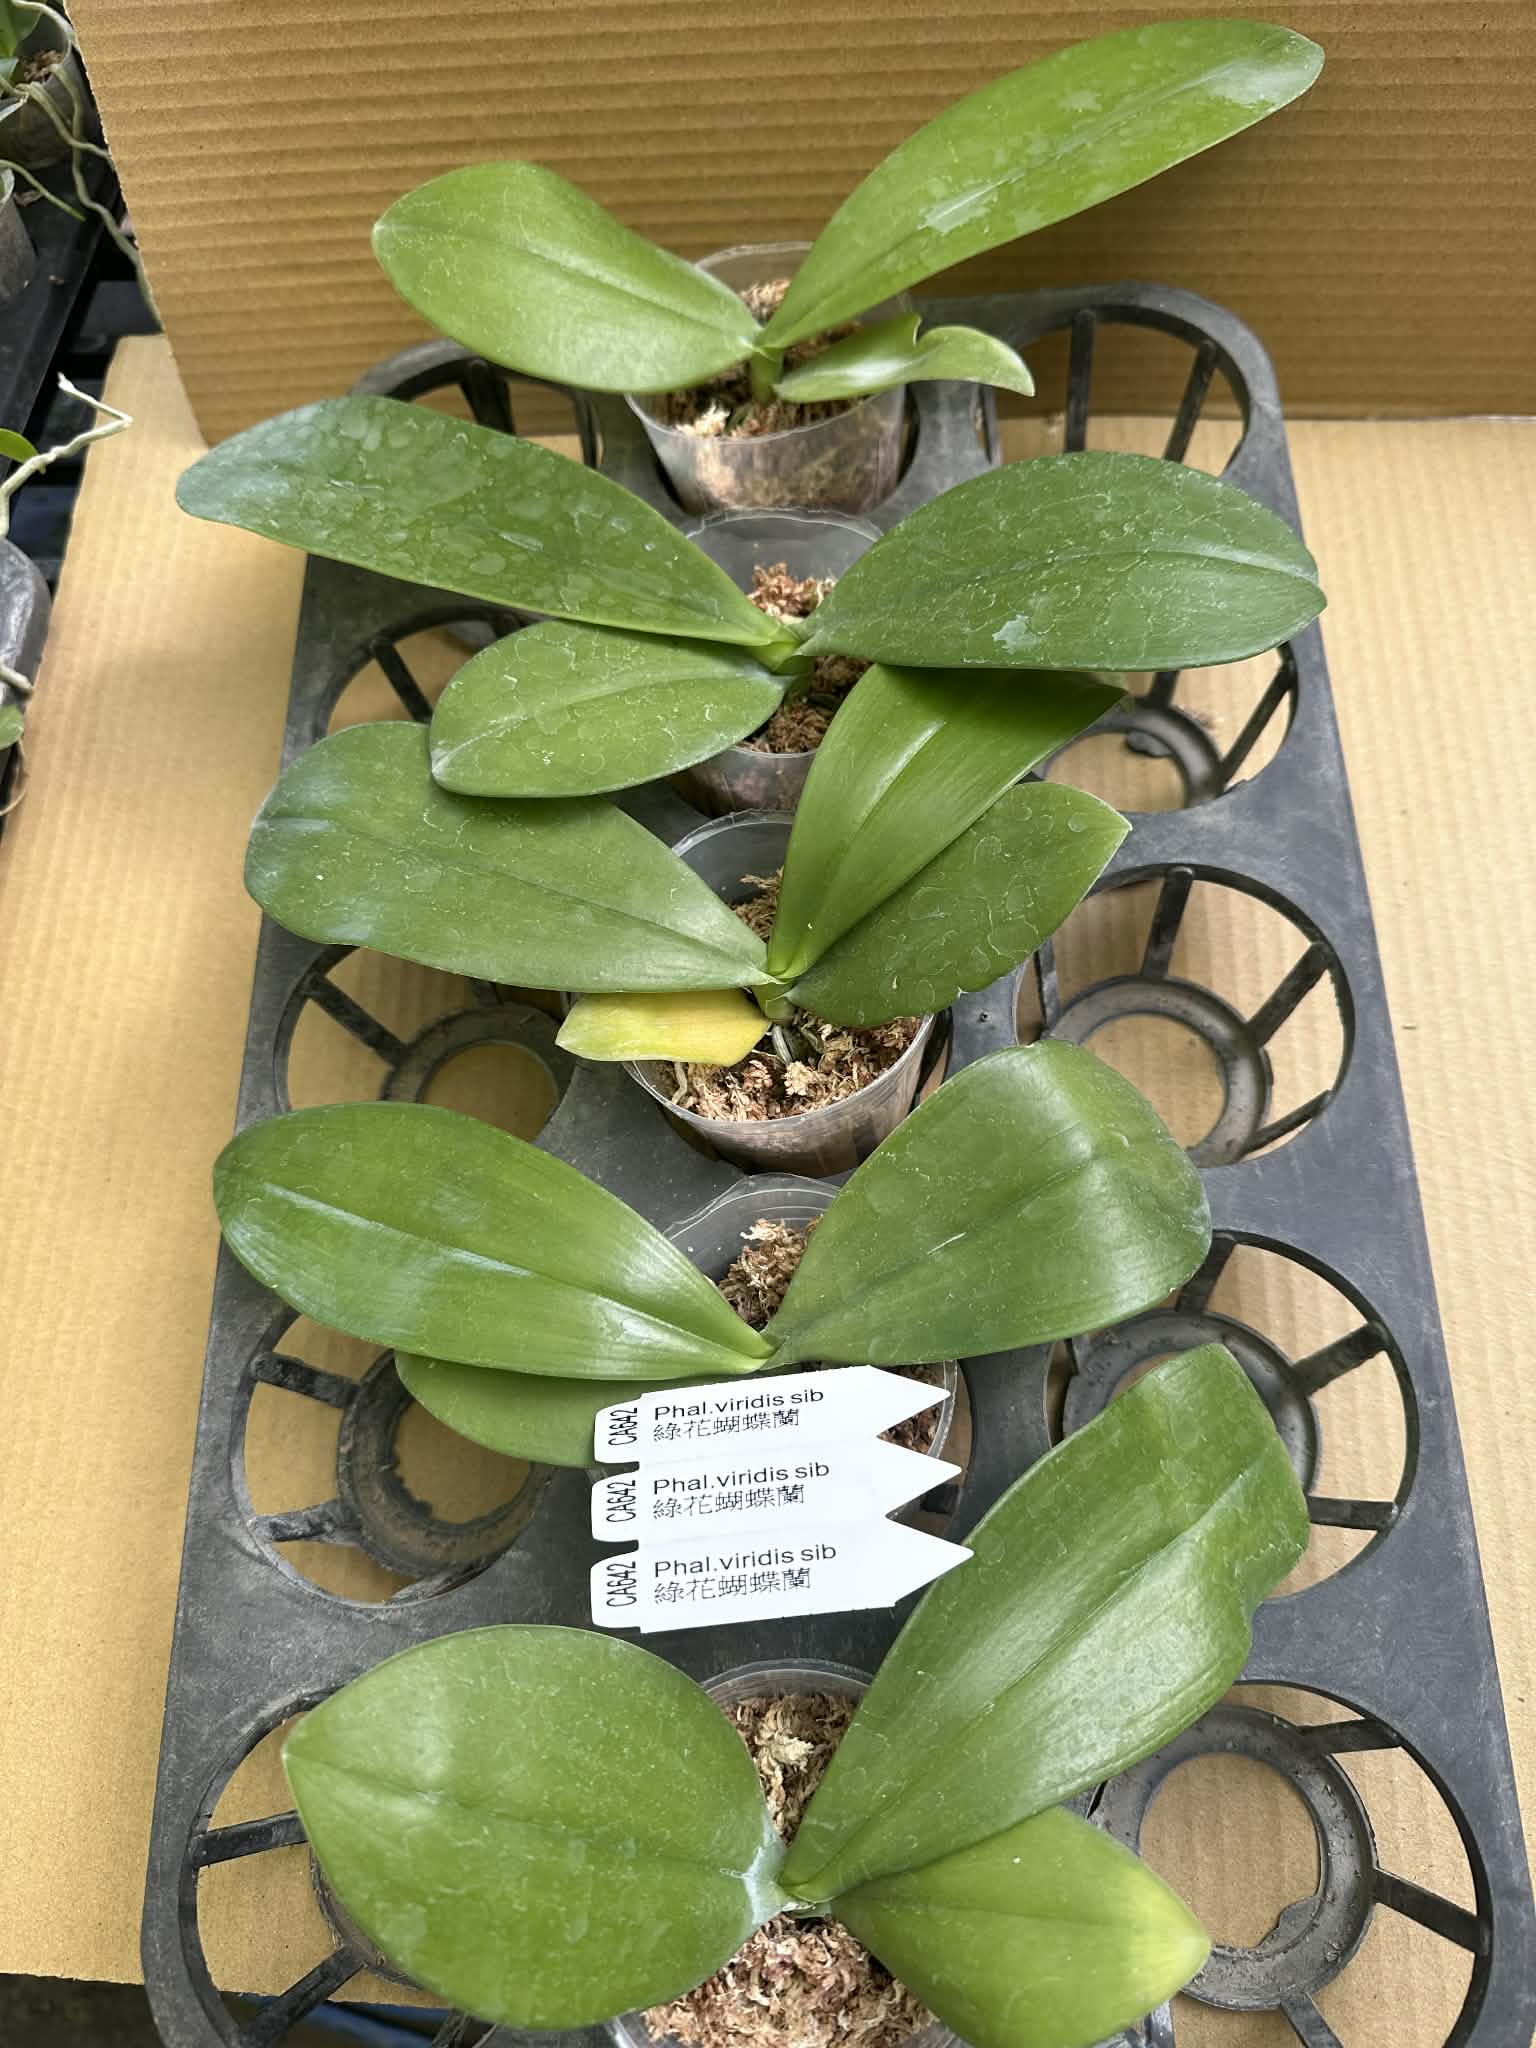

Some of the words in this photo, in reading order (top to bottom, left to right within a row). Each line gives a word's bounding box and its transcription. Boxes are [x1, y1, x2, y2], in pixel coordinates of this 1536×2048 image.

[654, 1392, 785, 1420] Phal.viridis
[790, 1388, 824, 1404] sib
[608, 1407, 638, 1446] CA642
[653, 1408, 800, 1442] 綠花蝴蝶蘭
[653, 1465, 789, 1495] Phal.viridis
[795, 1462, 830, 1478] sib
[606, 1479, 637, 1523] CA642
[653, 1484, 805, 1519] 綠花蝴蝶蘭
[654, 1548, 795, 1578] Phal.viridis
[800, 1543, 837, 1561] sib
[606, 1560, 637, 1607] CA642
[653, 1567, 811, 1604] 綠花蝴蝶蘭
